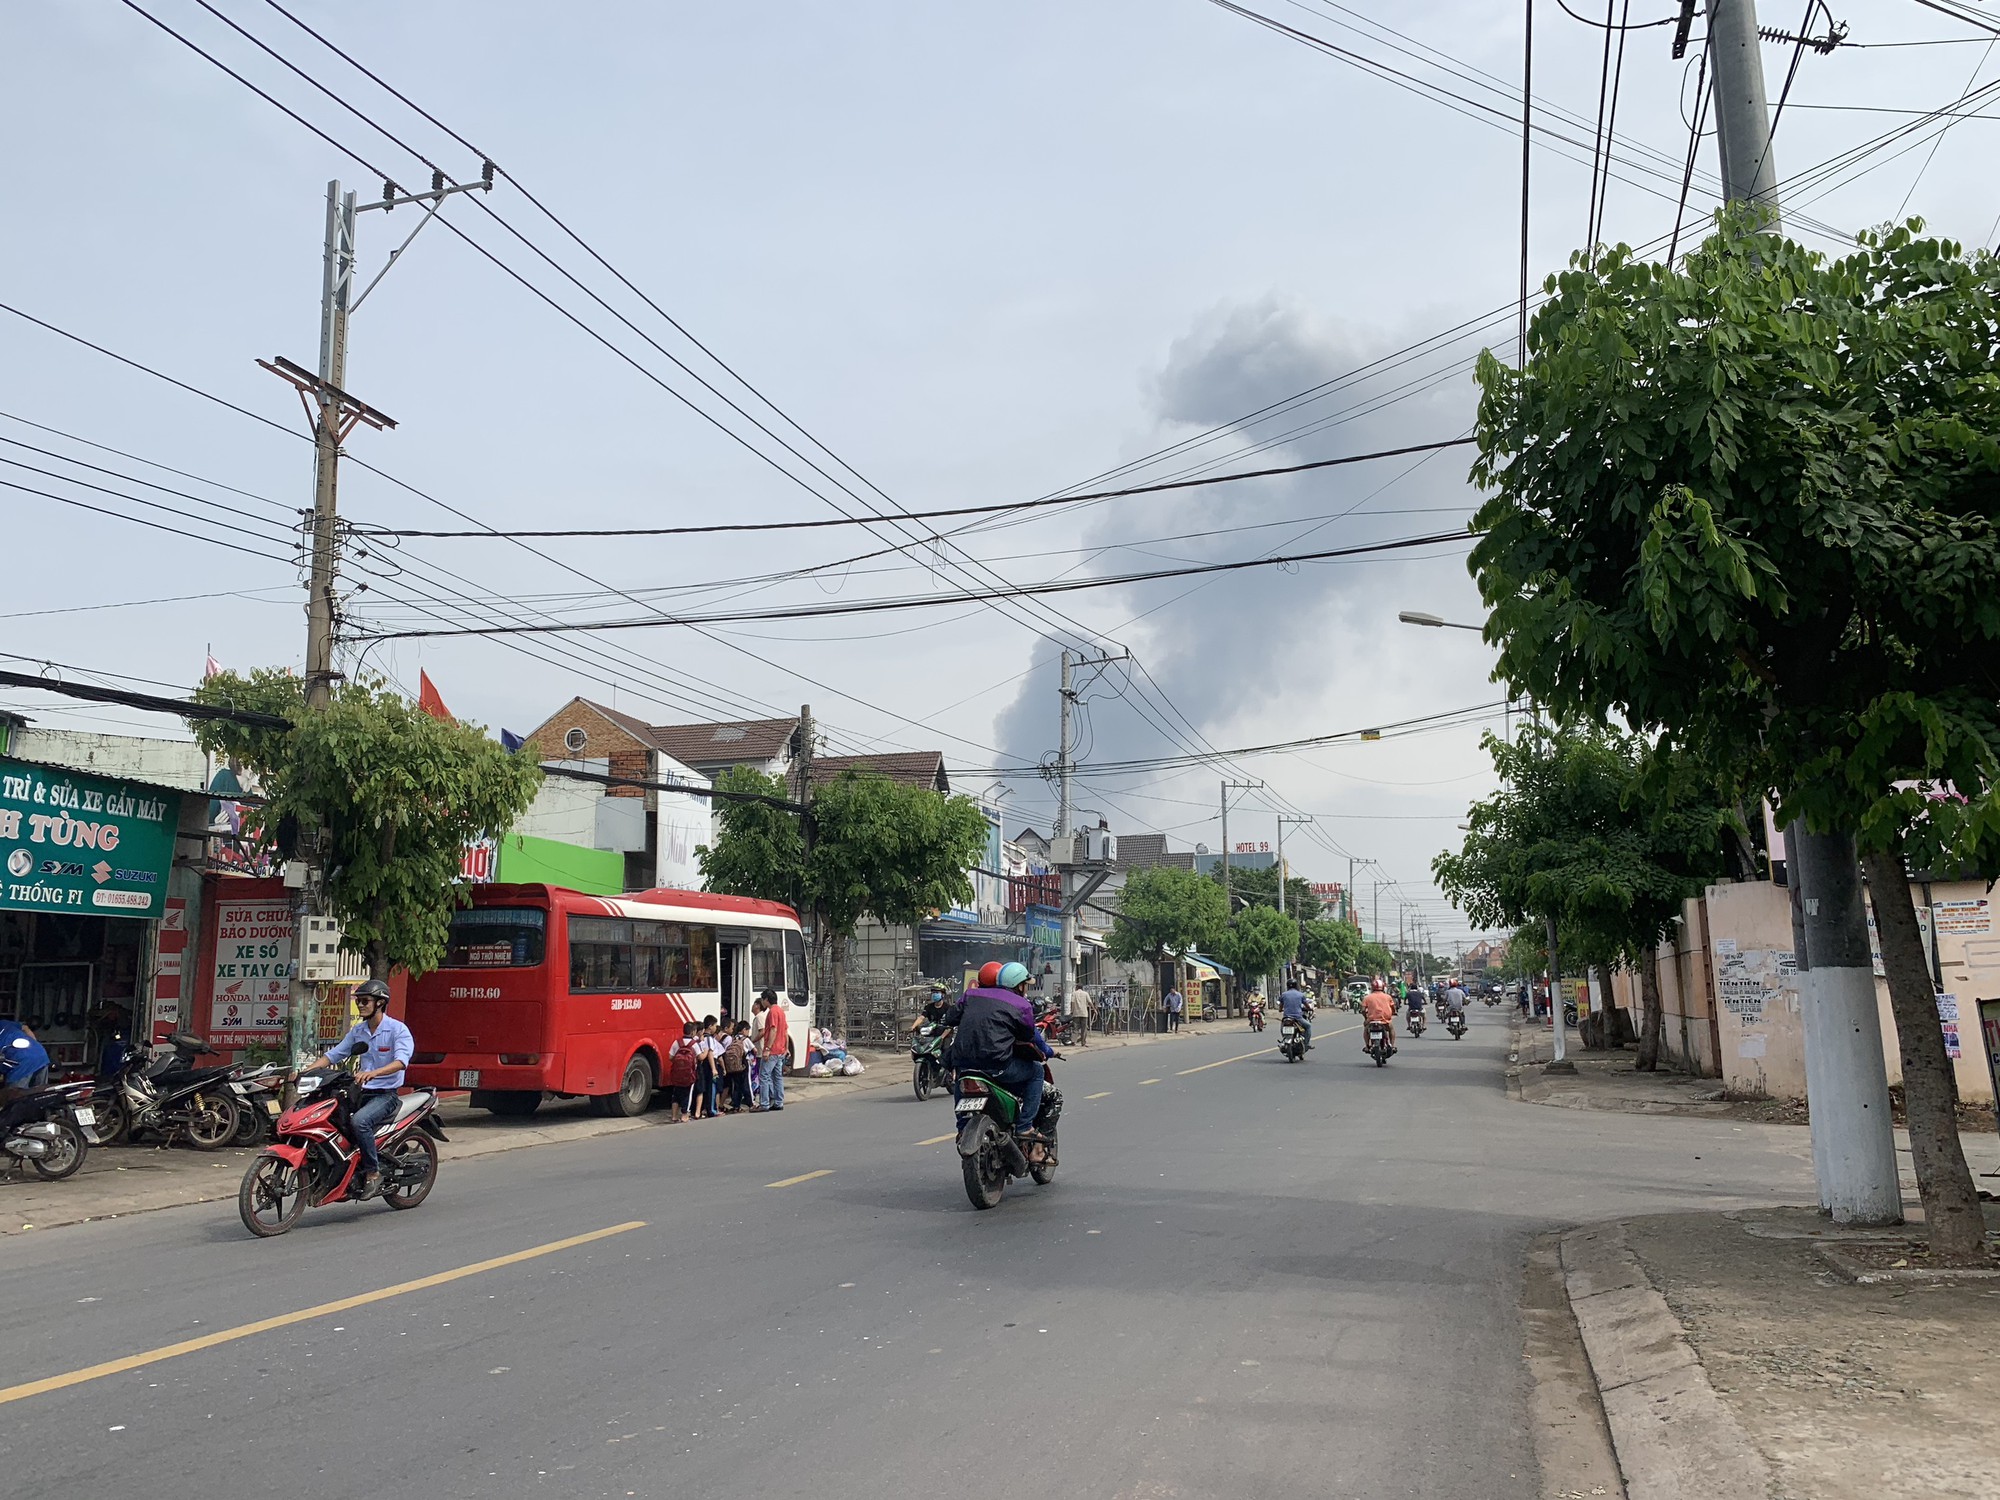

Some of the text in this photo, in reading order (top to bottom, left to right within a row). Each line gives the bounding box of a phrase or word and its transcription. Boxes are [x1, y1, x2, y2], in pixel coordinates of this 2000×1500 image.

[3, 773, 31, 801] TRÌ
[34, 782, 46, 804] &
[50, 779, 79, 809] SỬA
[82, 790, 103, 812] XE
[137, 796, 167, 822] MÁY
[29, 810, 119, 851] TÙNG
[1236, 841, 1269, 853] HOTEL 99
[38, 860, 84, 876] SYM
[115, 868, 157, 883] SUZUKI
[9, 880, 62, 904] THỐNG
[67, 889, 83, 905] FI
[225, 907, 292, 922] SỬA CHỮA
[220, 924, 247, 939] BẢO
[235, 939, 279, 958] XE SỐ
[217, 964, 236, 977] XE
[241, 964, 270, 977] TAY
[450, 987, 500, 998] 51B-113.60
[222, 1018, 242, 1026] SYM
[464, 1071, 475, 1079] 51B
